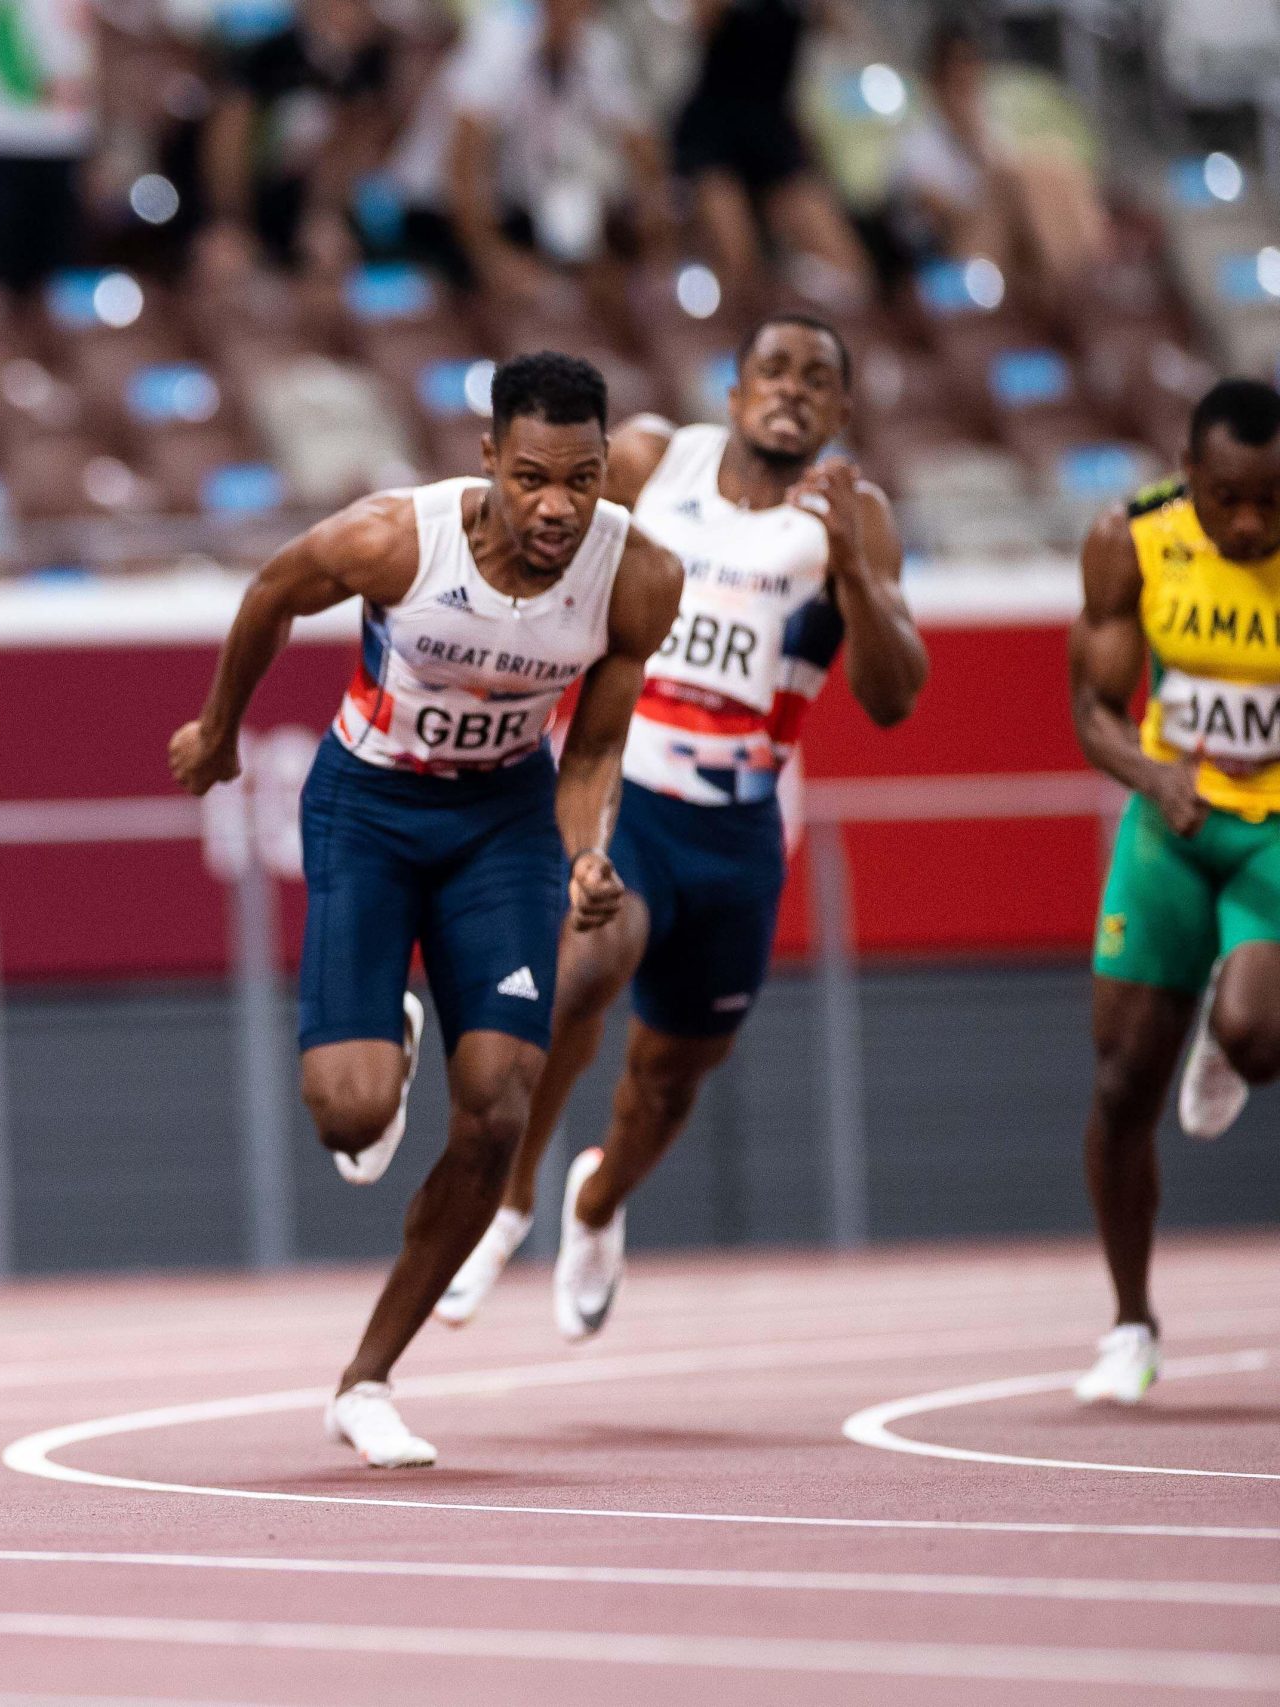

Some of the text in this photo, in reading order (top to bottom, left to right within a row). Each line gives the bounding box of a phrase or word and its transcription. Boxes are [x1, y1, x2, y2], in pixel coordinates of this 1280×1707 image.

[416, 635, 581, 680] GREAT BRITAIN
[416, 705, 528, 750] GBR
[1178, 693, 1280, 744] JAM
